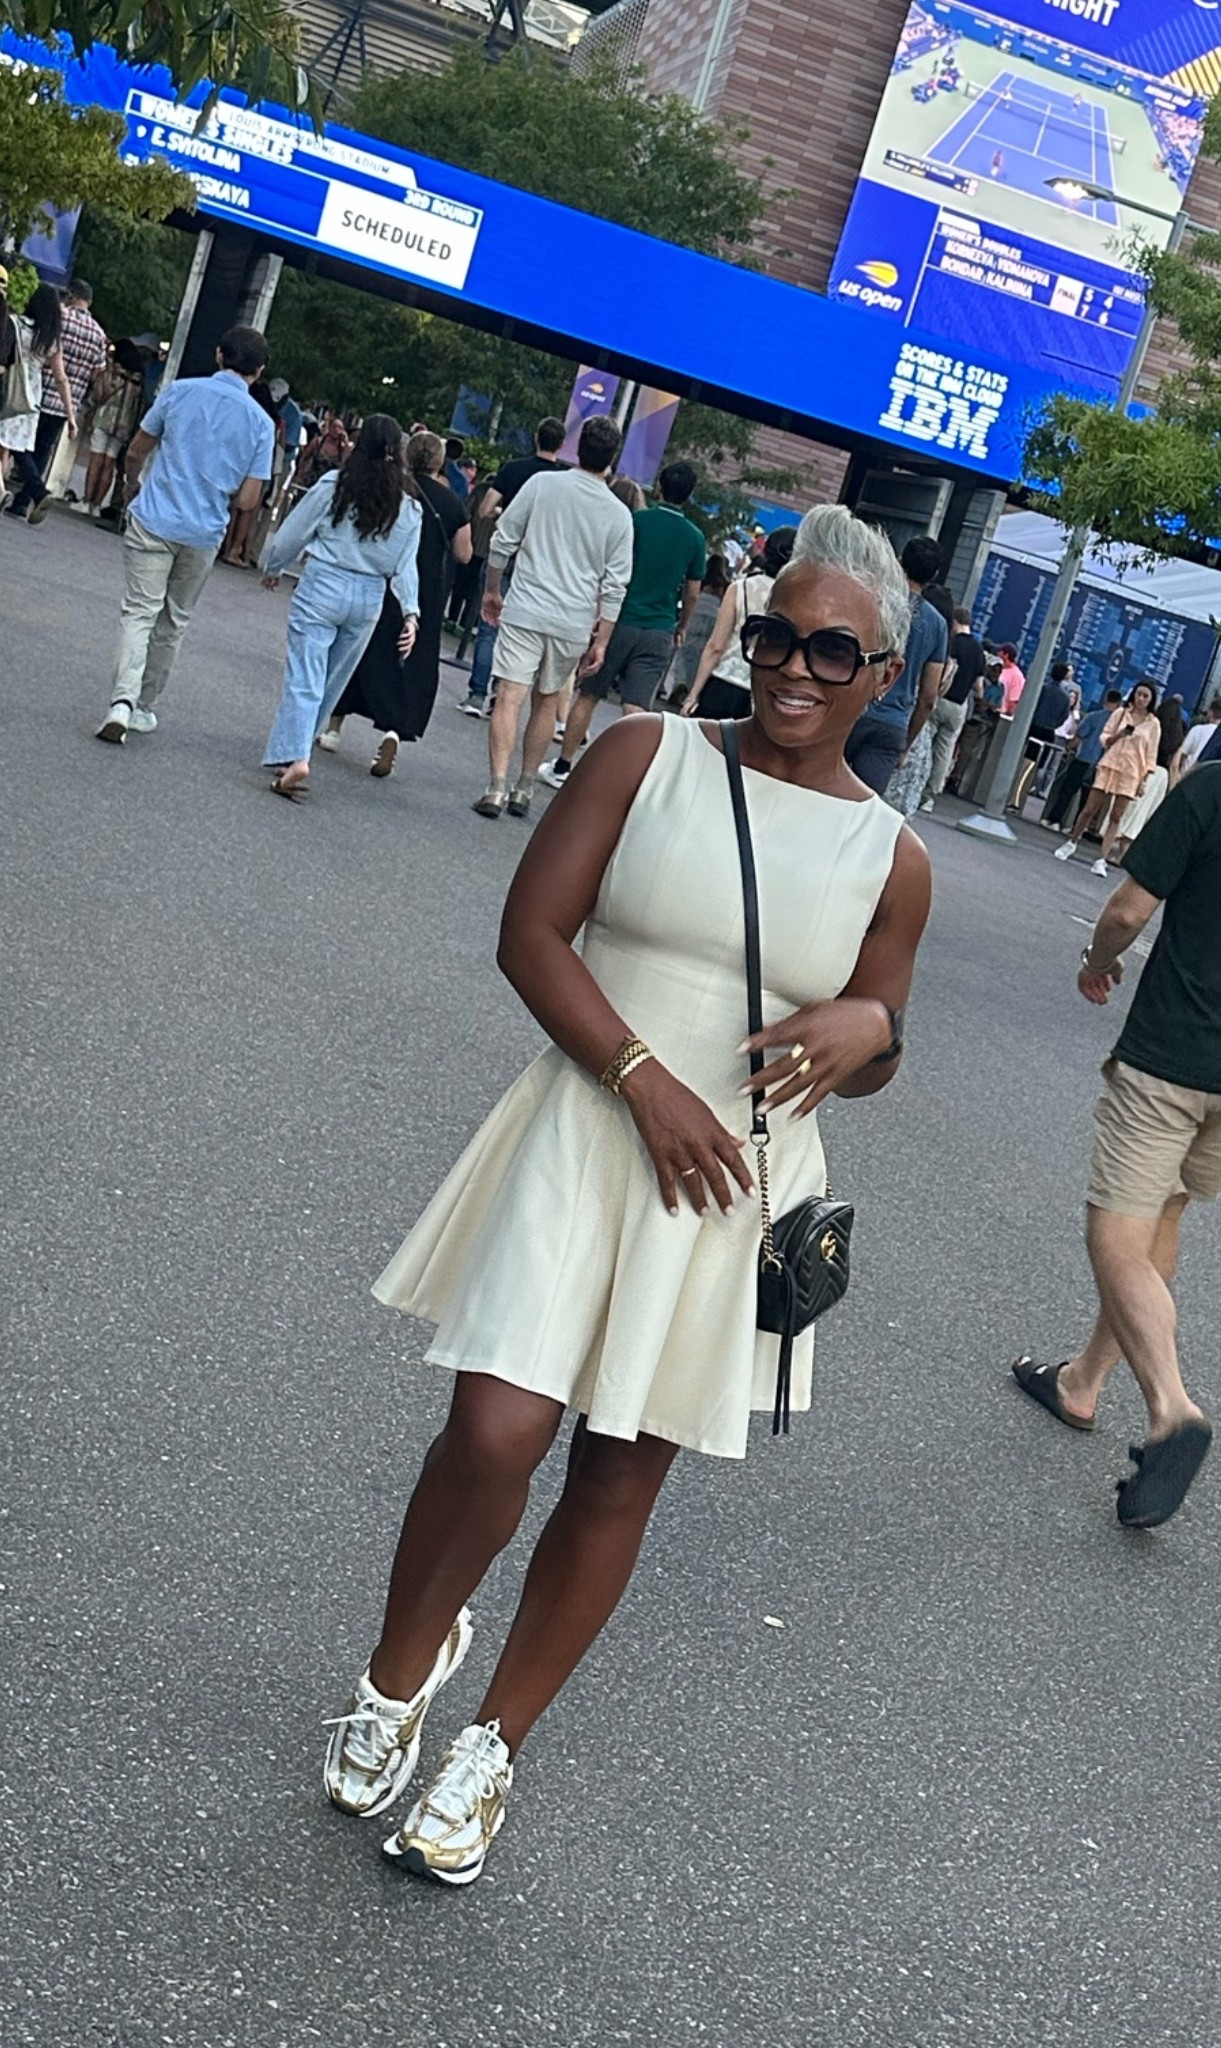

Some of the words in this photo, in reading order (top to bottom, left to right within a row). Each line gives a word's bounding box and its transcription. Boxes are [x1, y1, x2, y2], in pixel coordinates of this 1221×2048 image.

[1043, 0, 1120, 27] GHT
[167, 132, 240, 173] SVITOLINA
[222, 120, 294, 164] SINGLES
[229, 112, 263, 130] LOUIS
[341, 150, 390, 174] STADIUM
[403, 189, 431, 211] 3RD
[431, 199, 475, 226] ROUND
[341, 210, 452, 260] SCHEDULED
[859, 287, 903, 312] open
[1081, 303, 1090, 318] 7
[1099, 311, 1109, 326] 6
[1084, 287, 1095, 303] 5
[1103, 295, 1114, 310] 4
[895, 360, 915, 379] ON
[915, 365, 940, 388] THE
[939, 374, 964, 395] IBM
[963, 383, 1003, 409] CLOUD
[900, 342, 953, 374] SCORES
[952, 361, 964, 378] &
[965, 365, 1009, 393] STATS
[878, 376, 999, 460] IBM
